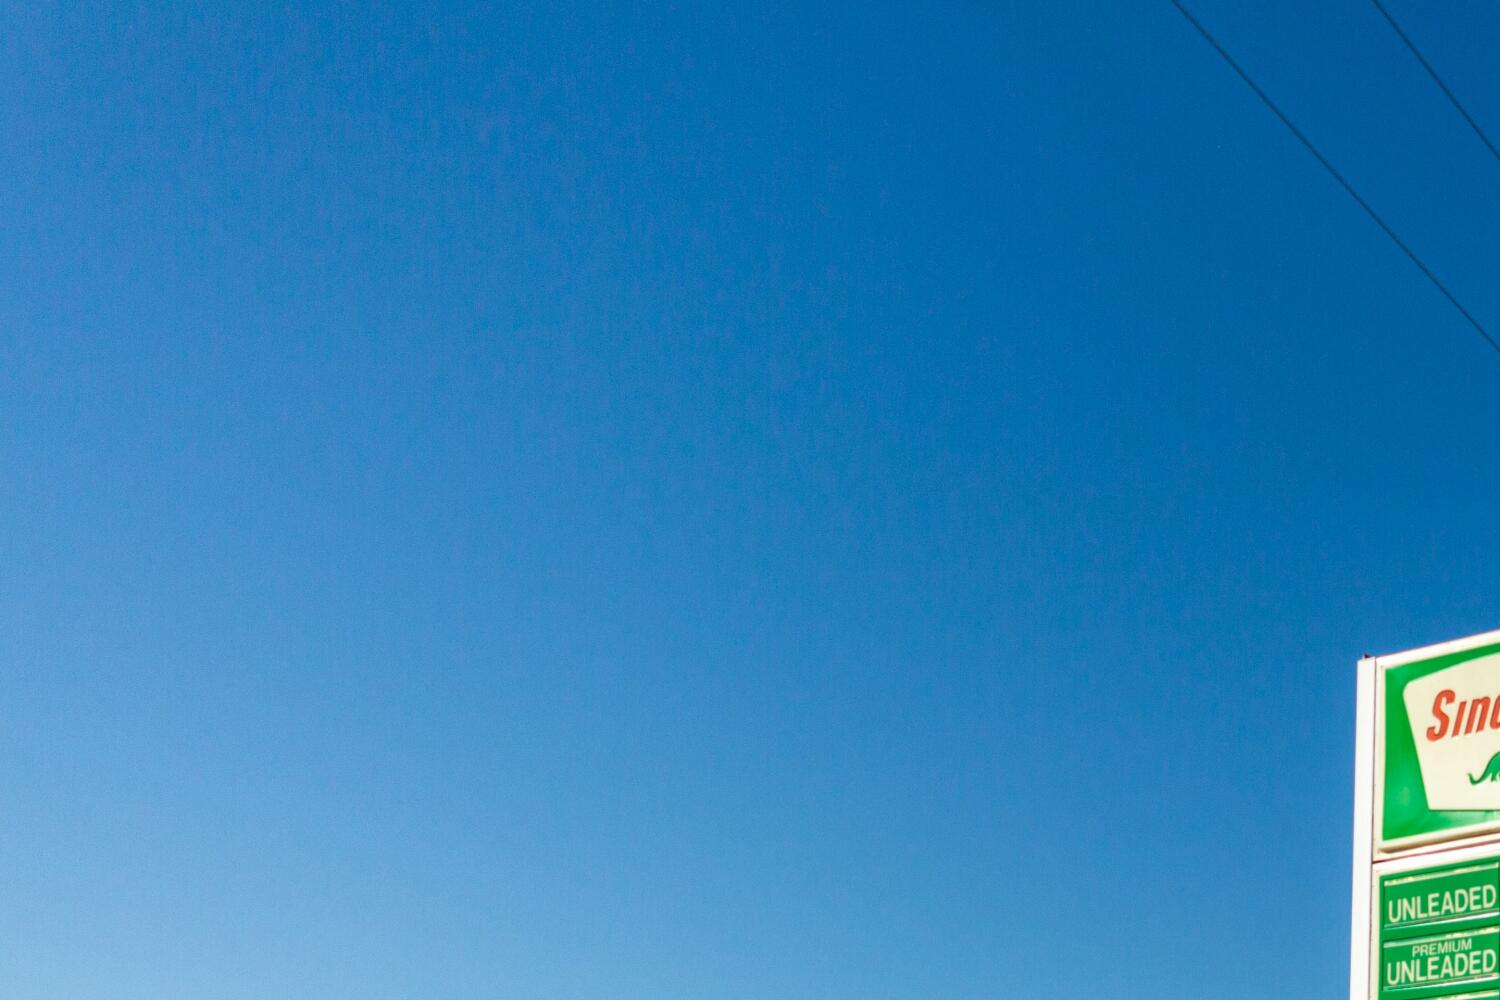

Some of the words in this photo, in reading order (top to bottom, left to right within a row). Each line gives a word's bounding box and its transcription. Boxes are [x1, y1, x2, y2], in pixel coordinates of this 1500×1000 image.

[1388, 884, 1497, 923] UNLEADED
[1412, 938, 1473, 958] PREMIUM
[1387, 949, 1497, 985] UNLEADED
